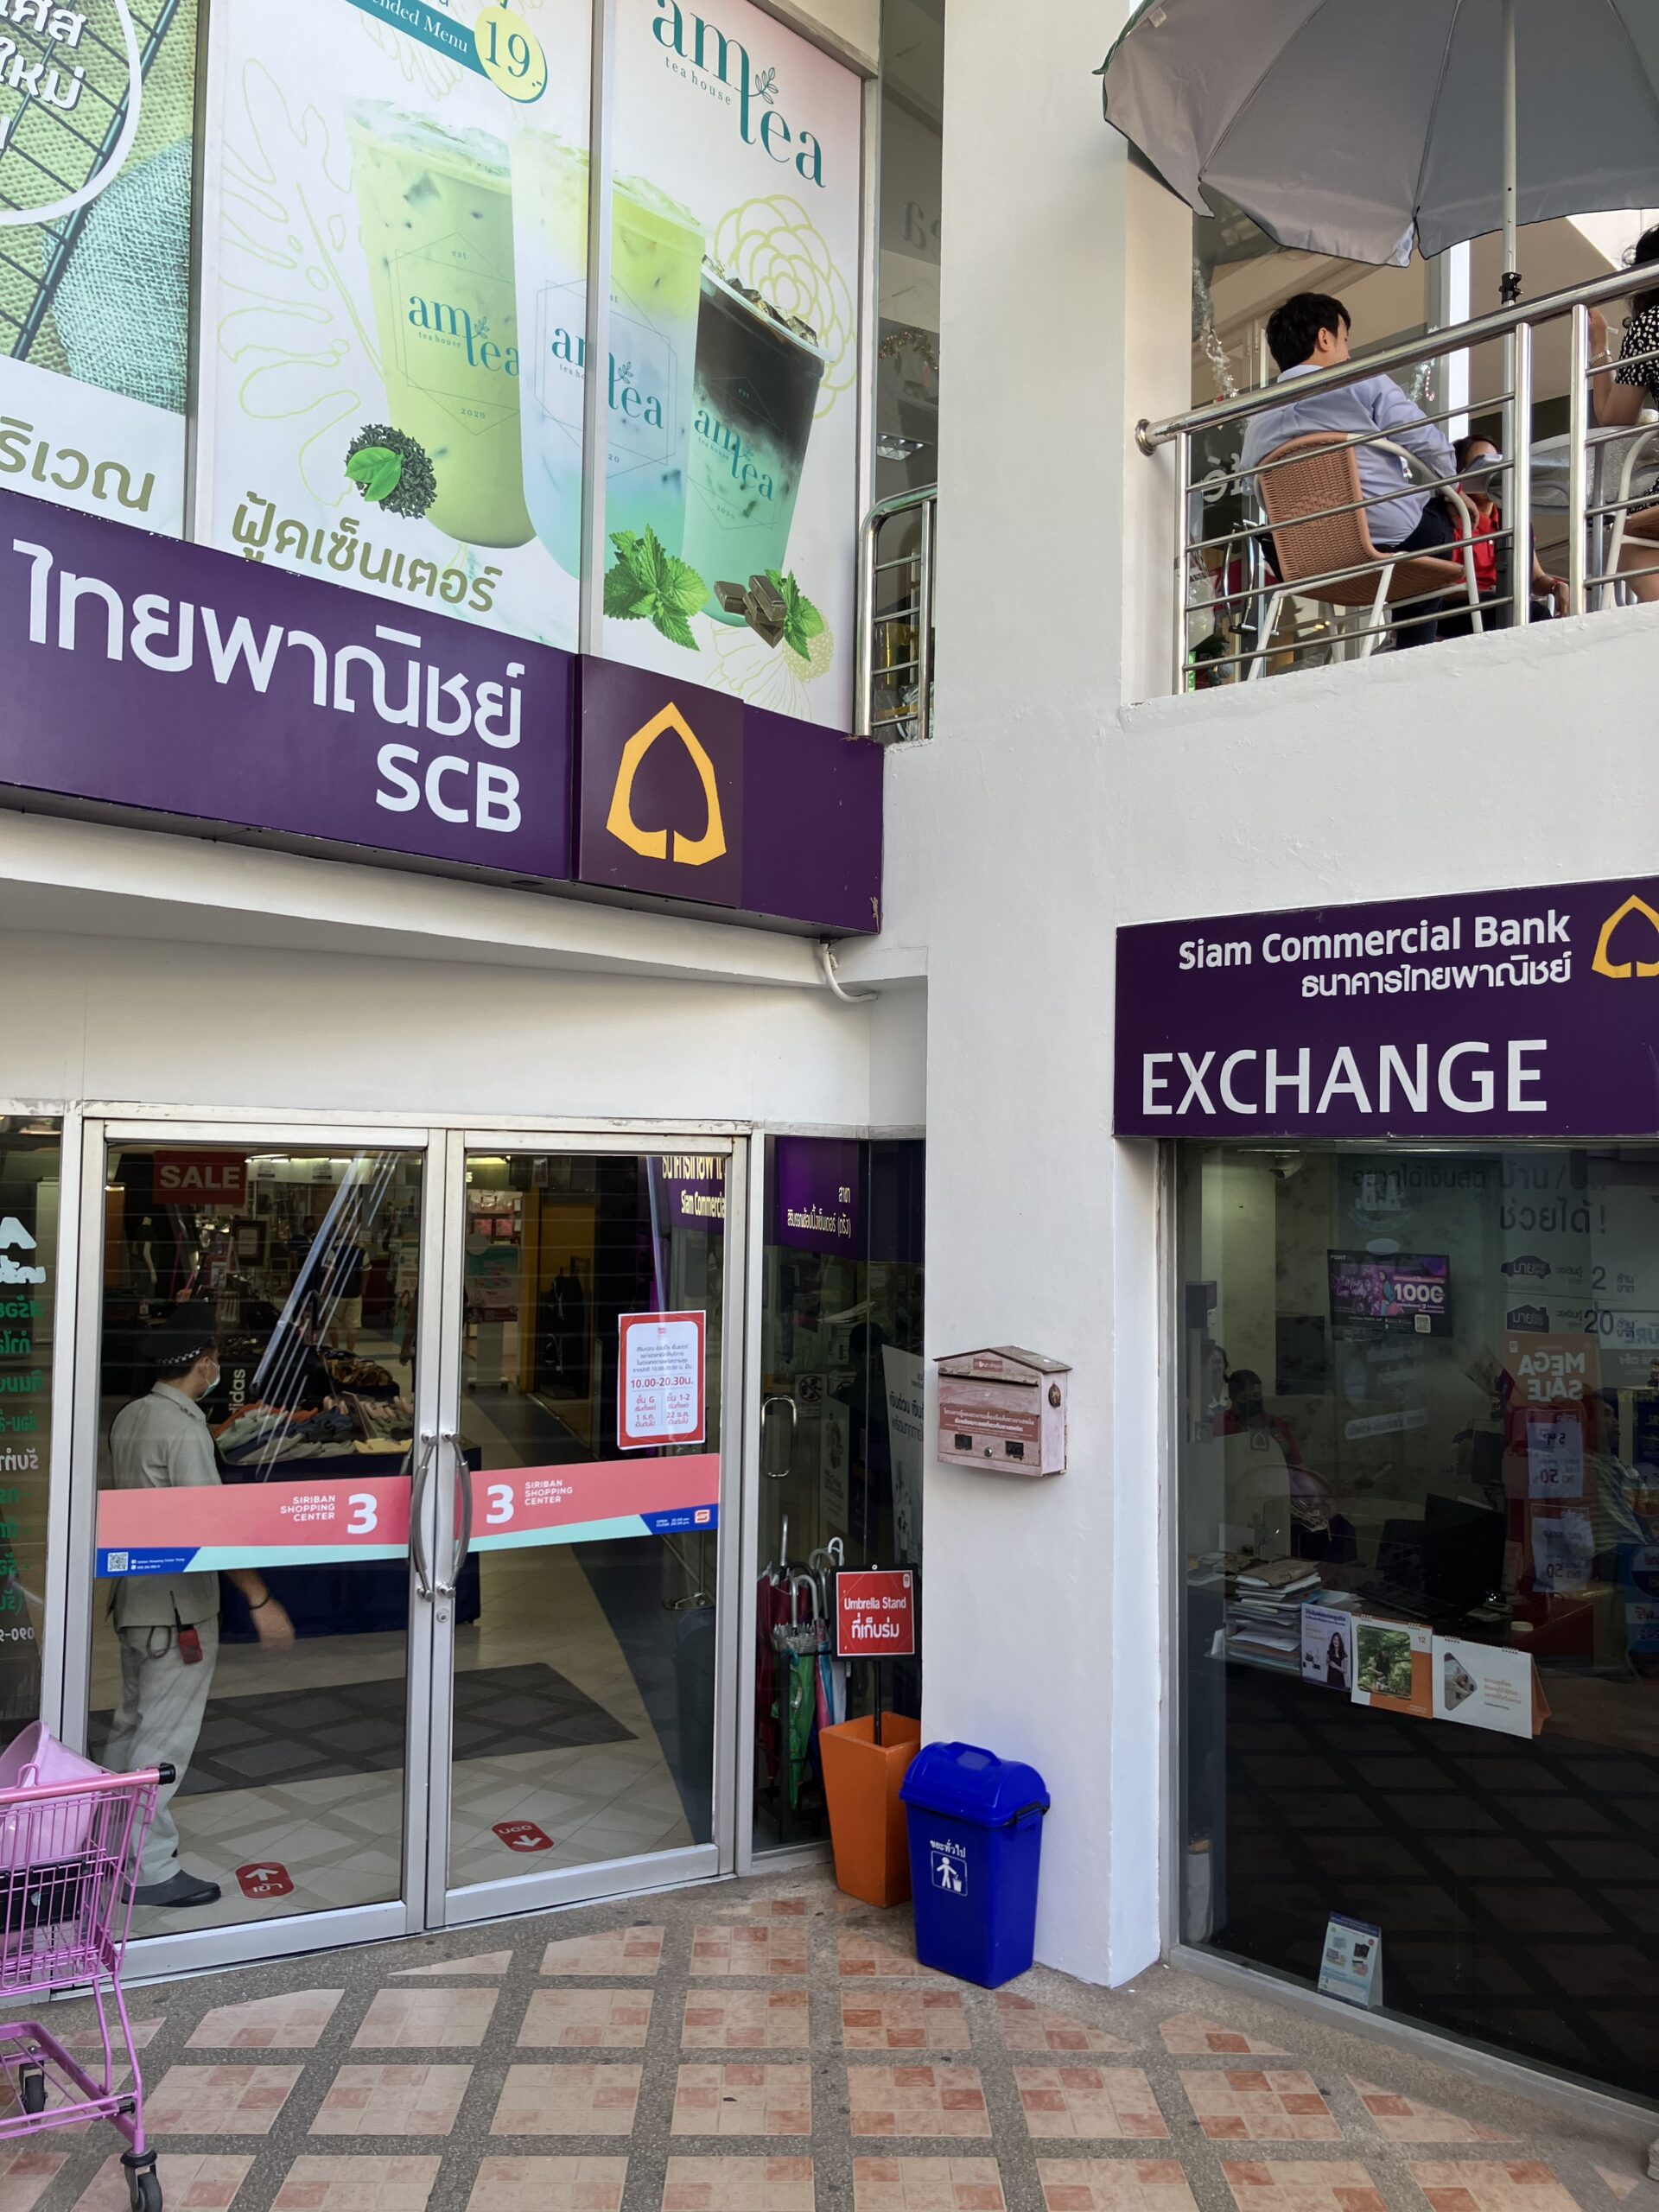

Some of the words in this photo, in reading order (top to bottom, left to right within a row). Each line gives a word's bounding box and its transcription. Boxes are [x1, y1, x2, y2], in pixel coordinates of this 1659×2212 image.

[423, 16, 467, 54] Menu
[665, 55, 687, 78] tea
[690, 70, 733, 105] house
[652, 0, 827, 188] amtea
[451, 250, 467, 260] est
[418, 331, 432, 341] tea
[435, 333, 462, 349] house
[460, 408, 486, 419] 2020
[694, 410, 774, 502] amtea
[715, 505, 735, 520] 2020
[12, 537, 526, 750] ไทยพาณิชย์
[375, 742, 522, 834] SCB
[1179, 937, 1253, 971] Siam
[1262, 917, 1462, 966] Commercial
[1475, 908, 1572, 950] Bank
[1300, 950, 1573, 999] ธนาคารไทยพาณิชย์
[1141, 1039, 1549, 1116] EXCHANGE
[160, 1166, 242, 1190] SALE
[681, 1189, 695, 1216] Siam
[1499, 1195, 1592, 1234] ช่วยได้
[1592, 1265, 1607, 1291] 2
[1583, 1309, 1615, 1336] 20
[631, 1376, 694, 1389] 10.00-20.30น.
[648, 1395, 655, 1404] G
[679, 1393, 690, 1402] 1-2
[524, 1478, 563, 1491] SIRIBAN
[524, 1485, 574, 1497] SHOPPING
[280, 1503, 336, 1514] SHOPPING
[292, 1495, 336, 1505] SIRIBAN
[486, 1484, 515, 1524] 3
[524, 1494, 563, 1506] CENTER
[292, 1510, 336, 1522] CENTER
[346, 1492, 378, 1535] 3
[843, 1596, 881, 1611] Umbrella
[881, 1595, 908, 1610] Stand
[850, 1611, 900, 1641] ที่เก็บร่ม
[1417, 1636, 1427, 1645] 12
[929, 1838, 967, 1859] ขยะทั่วไป
